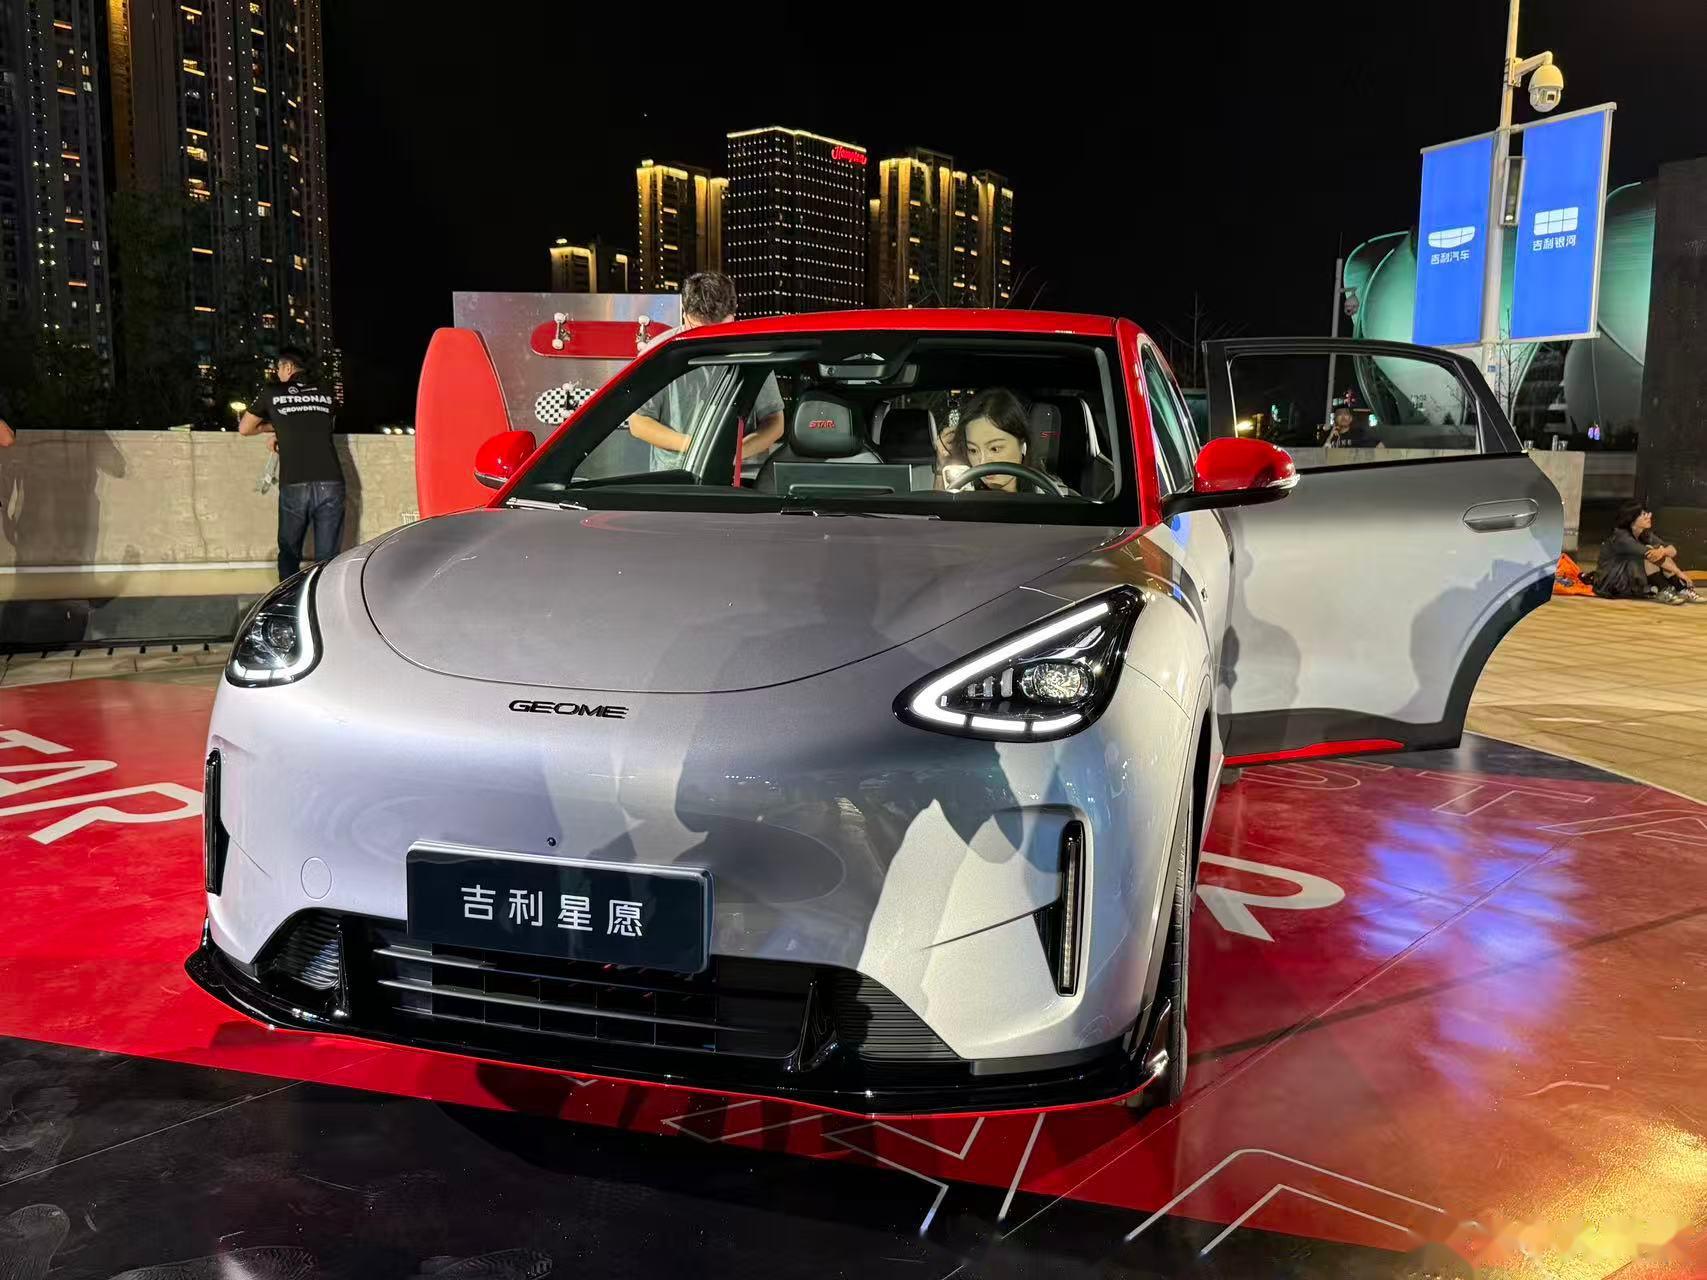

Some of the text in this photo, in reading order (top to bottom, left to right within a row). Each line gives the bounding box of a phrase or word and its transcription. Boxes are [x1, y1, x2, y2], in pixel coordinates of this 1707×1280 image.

[1532, 235, 1577, 251] 吉利银河
[1431, 250, 1470, 265] 吉利汽车
[272, 394, 332, 405] PETRONAS
[508, 699, 629, 719] GEOME
[461, 884, 643, 937] 吉利星愿
